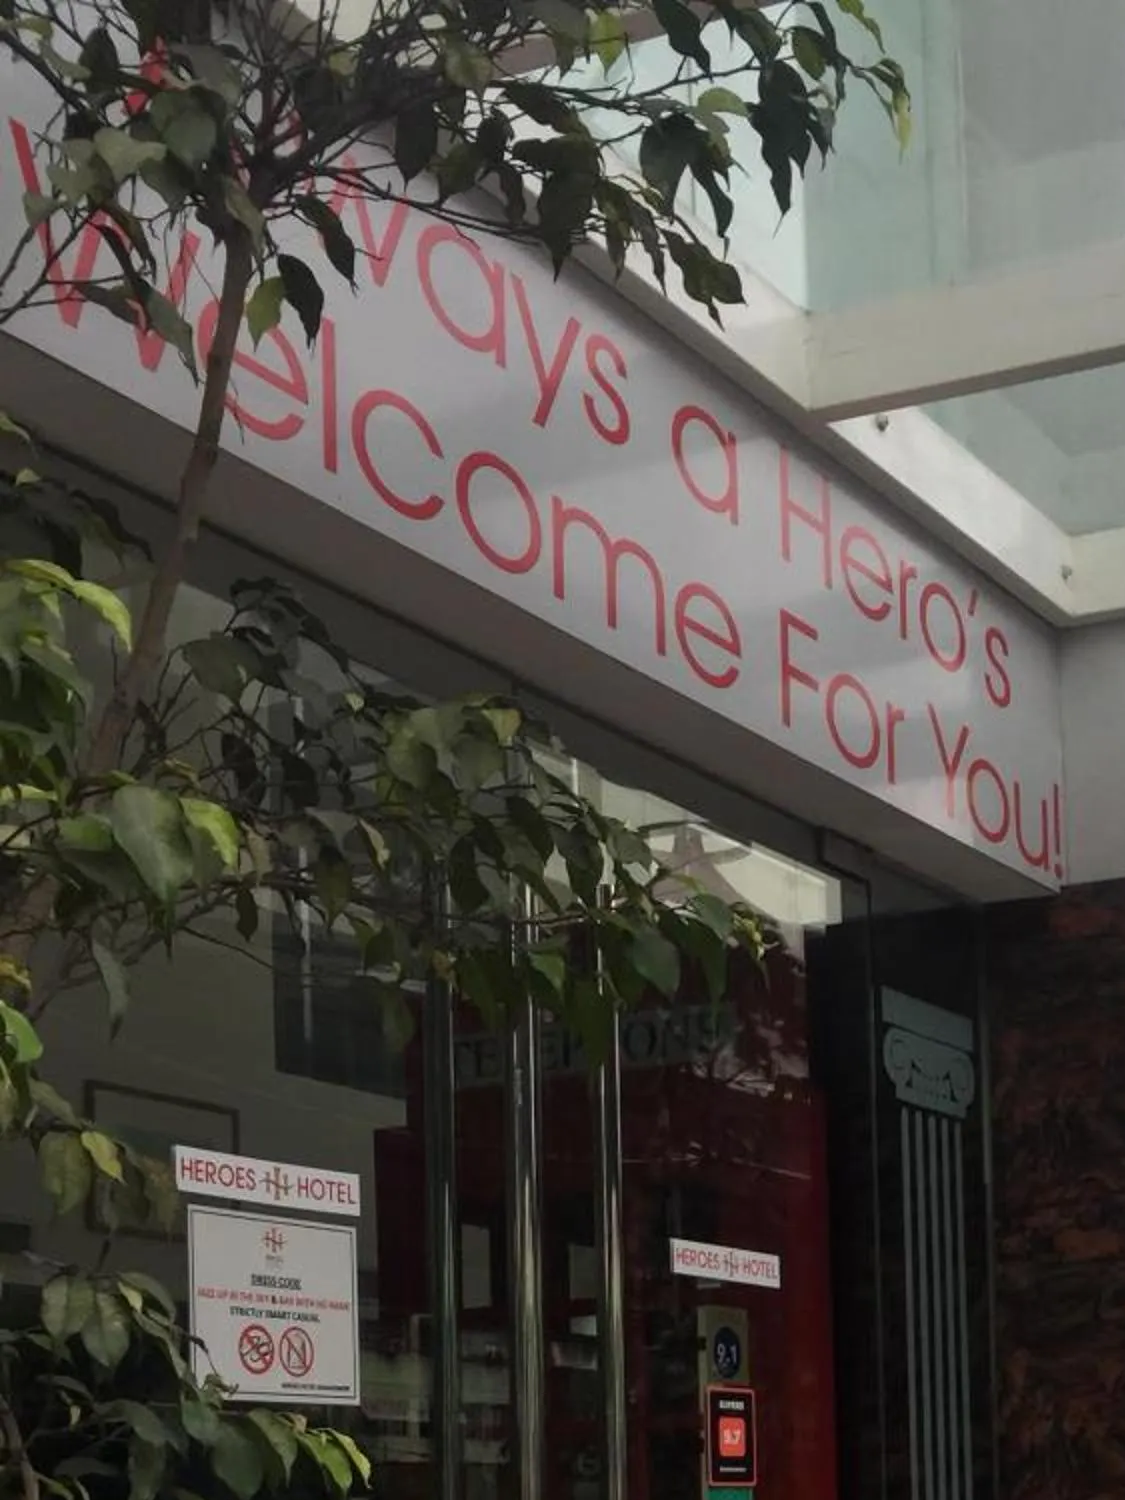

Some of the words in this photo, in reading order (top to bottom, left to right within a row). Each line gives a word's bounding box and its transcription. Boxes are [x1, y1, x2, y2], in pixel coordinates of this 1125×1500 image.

[671, 404, 740, 526] a
[778, 446, 1012, 708] Hero's
[779, 609, 905, 785] For
[928, 703, 1065, 877] You!
[180, 1156, 257, 1192] HEROES
[297, 1176, 357, 1206] HOTEL
[675, 1247, 721, 1270] HEROES
[743, 1260, 778, 1280] HOTEL
[716, 1341, 738, 1364] 9.1
